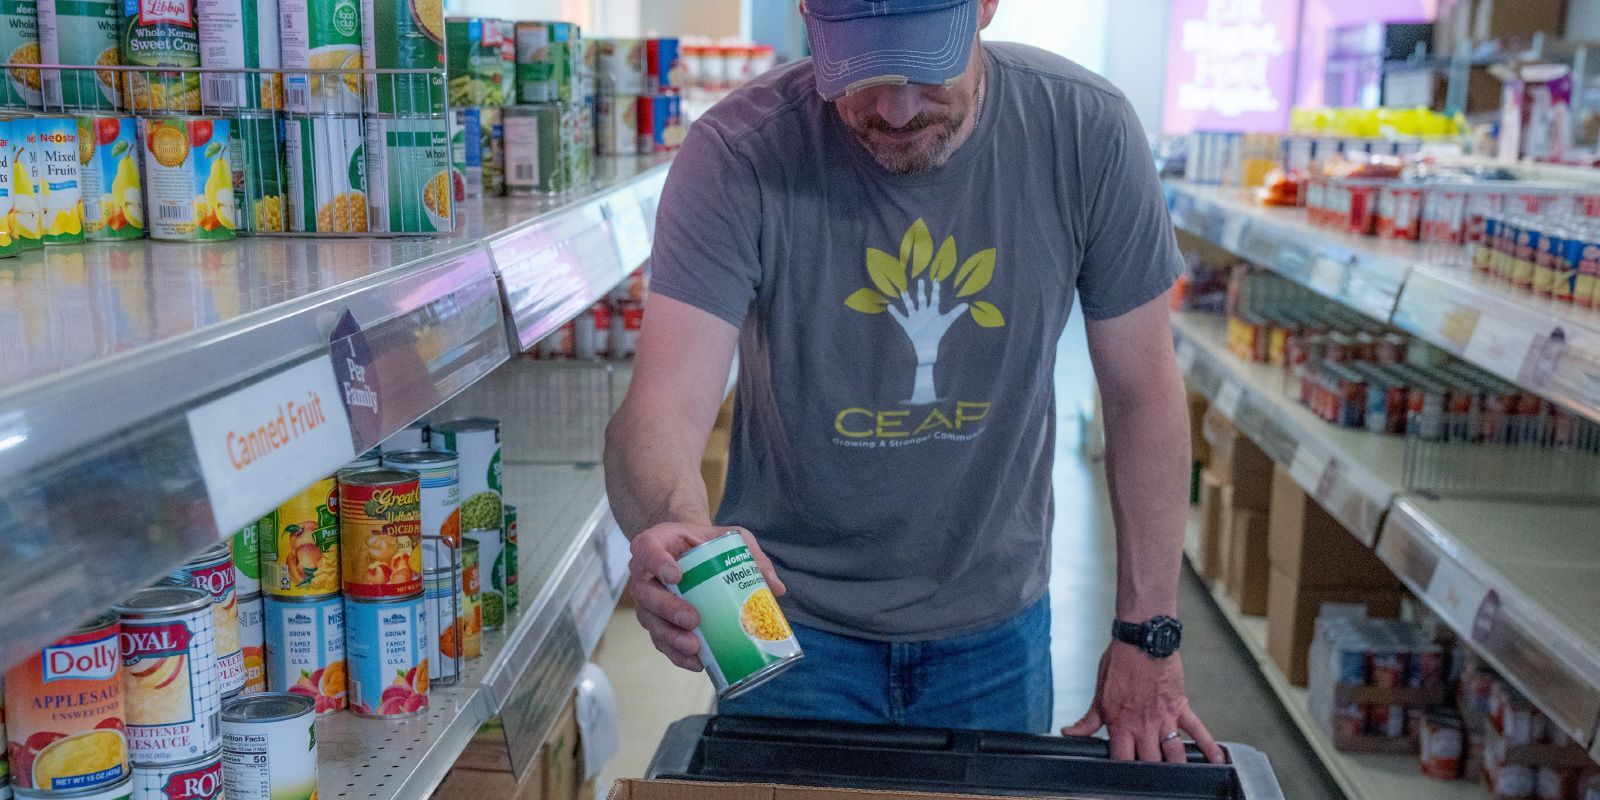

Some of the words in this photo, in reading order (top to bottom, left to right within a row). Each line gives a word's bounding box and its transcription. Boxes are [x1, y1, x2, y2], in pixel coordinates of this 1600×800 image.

[144, 0, 186, 16] Libby's
[134, 28, 165, 37] Whole
[131, 39, 172, 51] Sweet
[45, 151, 76, 162] Mixed
[47, 165, 77, 176] Fruits
[346, 357, 366, 383] Per
[343, 381, 378, 414] Family
[834, 400, 992, 438] CEAP
[226, 404, 288, 470] Canned
[288, 389, 327, 438] Fruit
[832, 436, 876, 448] Growing
[889, 432, 931, 448] Stronger
[372, 488, 415, 513] Great
[387, 525, 413, 536] DICED
[722, 567, 752, 585] Whole
[120, 631, 177, 657] OYAL
[50, 644, 117, 675] Dolly
[127, 736, 191, 750] LESAUCE
[254, 755, 267, 764] 50
[56, 778, 72, 786] NET
[73, 776, 85, 785] WT
[87, 775, 95, 783] 15
[96, 772, 106, 780] OZ
